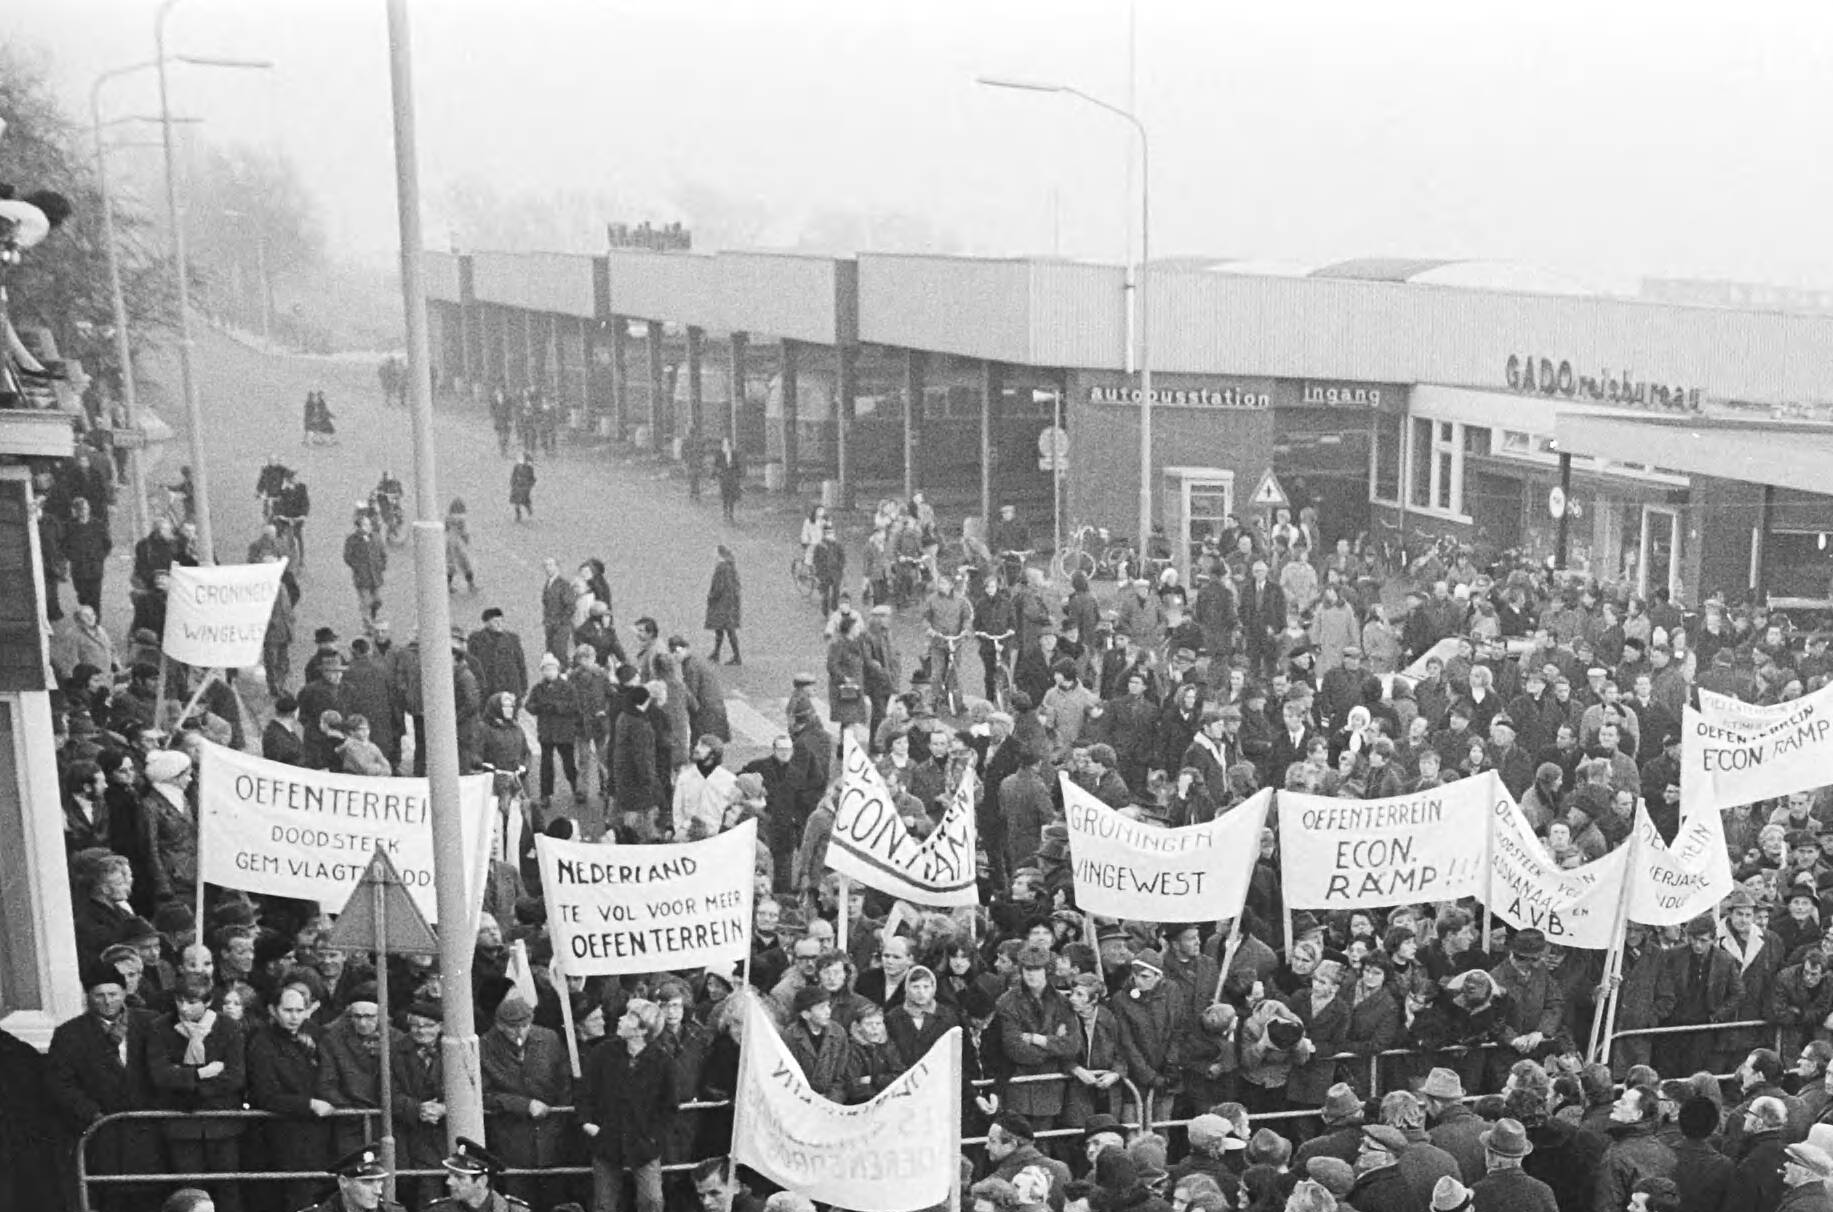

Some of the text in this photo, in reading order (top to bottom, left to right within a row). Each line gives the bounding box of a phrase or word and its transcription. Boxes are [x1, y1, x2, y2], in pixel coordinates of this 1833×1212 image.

[1506, 354, 1573, 397] GADO
[235, 774, 430, 825] OEFENTERREI
[1301, 797, 1442, 830] OEFENTERREIN
[1070, 804, 1213, 852] GRONINGEN
[1336, 836, 1417, 869] ECON.
[287, 858, 432, 887] VLAGTDD
[557, 857, 697, 885] NEDERLAND
[560, 889, 742, 923] TE VOL VOOR MEER
